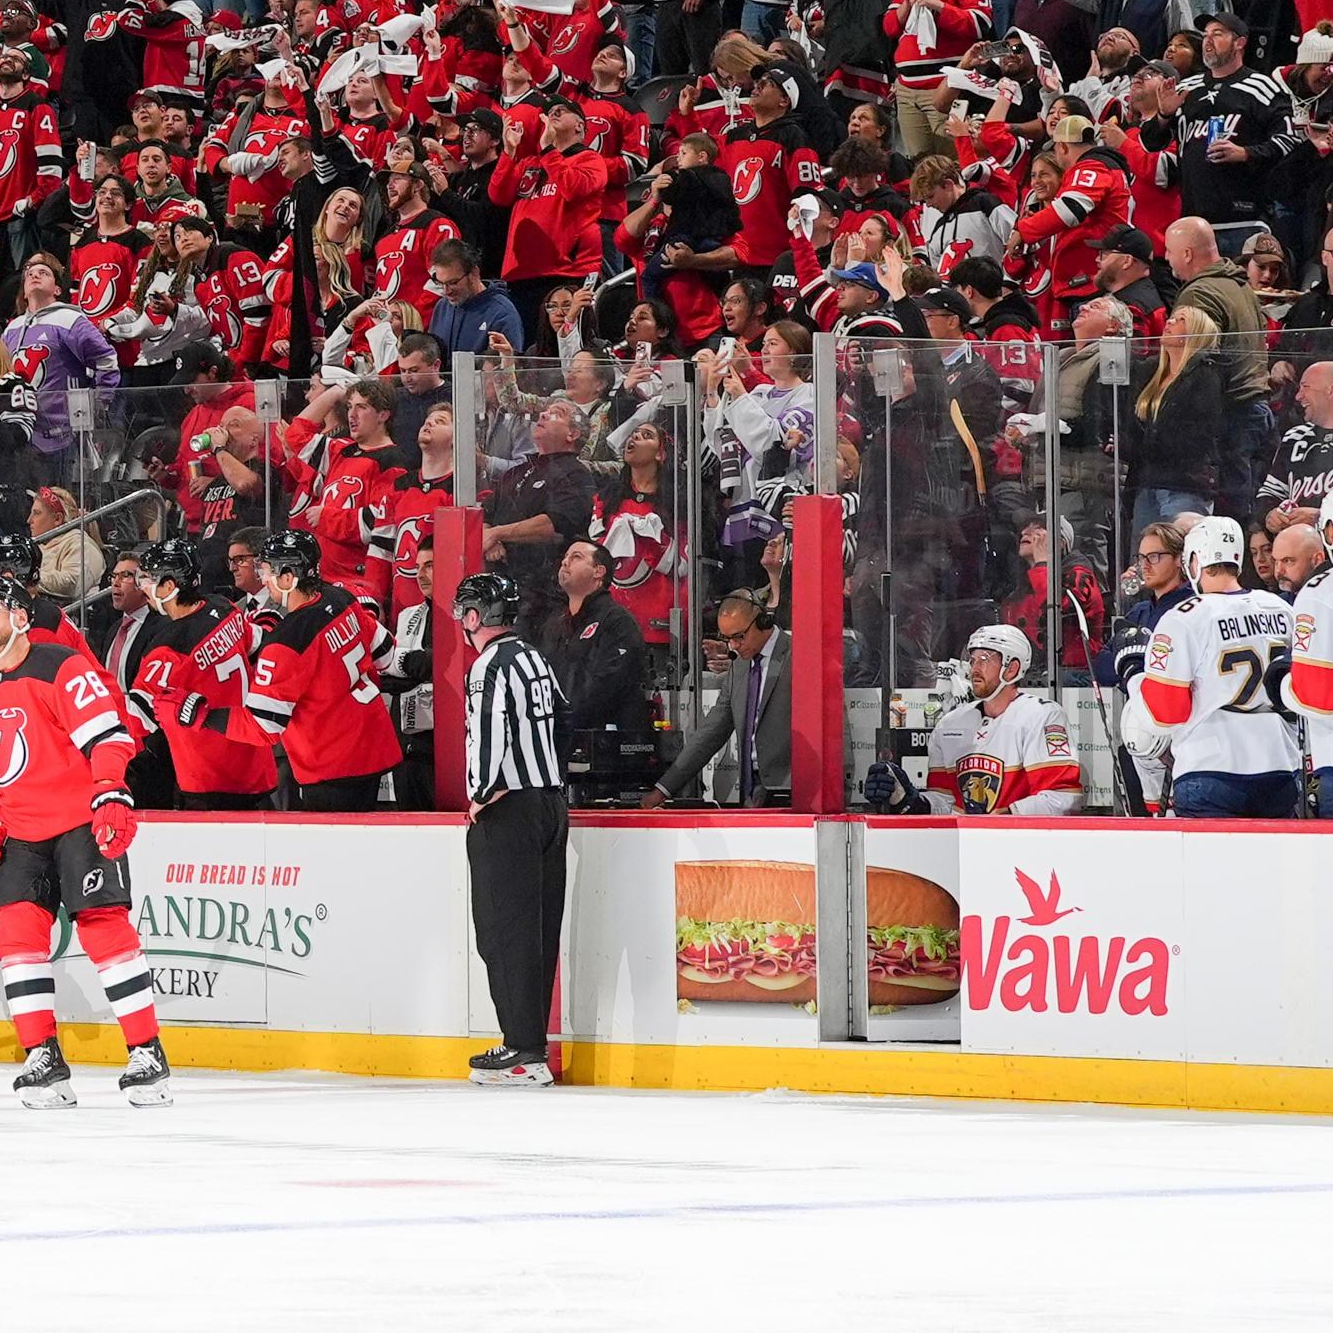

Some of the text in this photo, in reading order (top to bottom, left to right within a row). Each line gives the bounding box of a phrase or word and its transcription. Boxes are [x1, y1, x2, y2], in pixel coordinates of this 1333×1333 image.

[315, 11, 329, 28] 4
[12, 111, 24, 129] C
[39, 115, 53, 134] 4
[287, 119, 302, 136] C
[1176, 112, 1237, 147] Jersy
[354, 127, 369, 142] C
[772, 151, 782, 168] A
[798, 160, 820, 184] 86
[1071, 170, 1096, 189] 13
[399, 230, 415, 250] A
[235, 261, 262, 286] 13
[210, 277, 221, 294] C
[1000, 341, 1025, 366] 13
[1223, 533, 1235, 543] 26
[1219, 616, 1288, 643] BALINSKIS
[146, 660, 173, 689] 71
[254, 660, 275, 686] 5
[342, 644, 382, 704] 5
[66, 671, 110, 709] 28
[470, 680, 485, 695] 98
[531, 678, 553, 723] 98
[959, 757, 997, 773] FLORIDA
[166, 864, 300, 886] OUR BREAD IS HOT
[137, 895, 313, 958] ANDRA'S
[960, 914, 1170, 1016] Wawa
[149, 968, 219, 998] KERY
